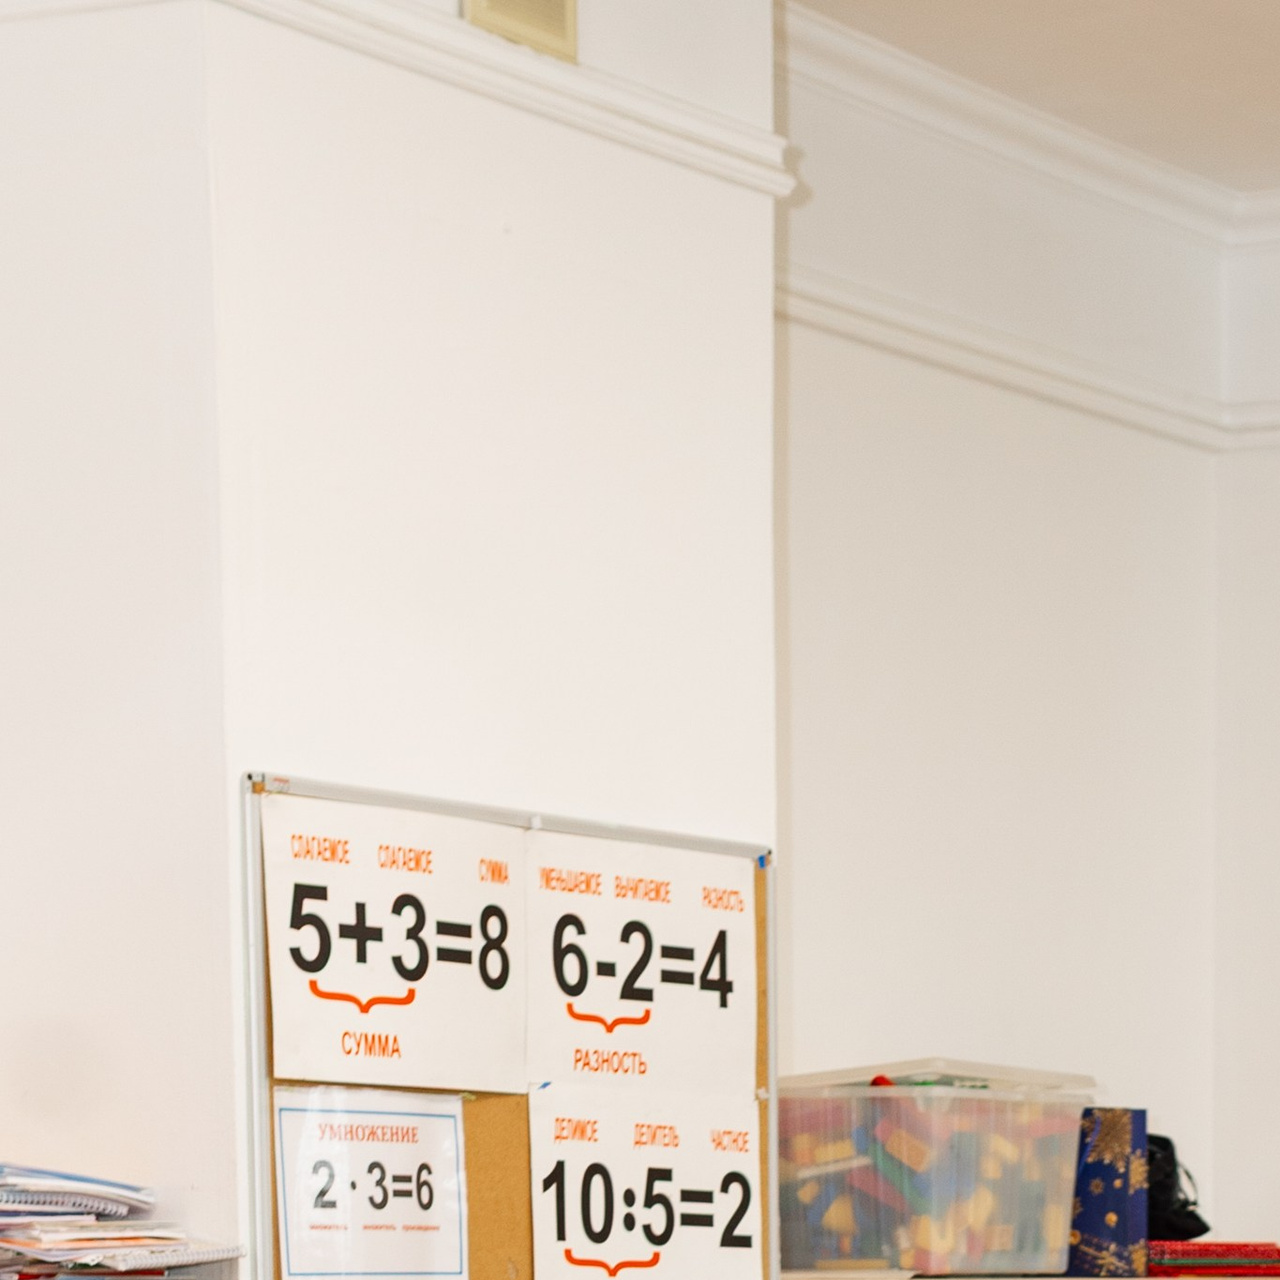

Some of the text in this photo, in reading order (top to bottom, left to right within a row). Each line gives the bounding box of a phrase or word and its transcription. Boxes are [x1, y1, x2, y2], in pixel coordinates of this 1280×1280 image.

[340, 1029, 402, 1060] СУММА
[572, 1046, 649, 1077] РАЗНОСТЬ
[318, 1122, 420, 1145] УМНОЖЕНИЕ
